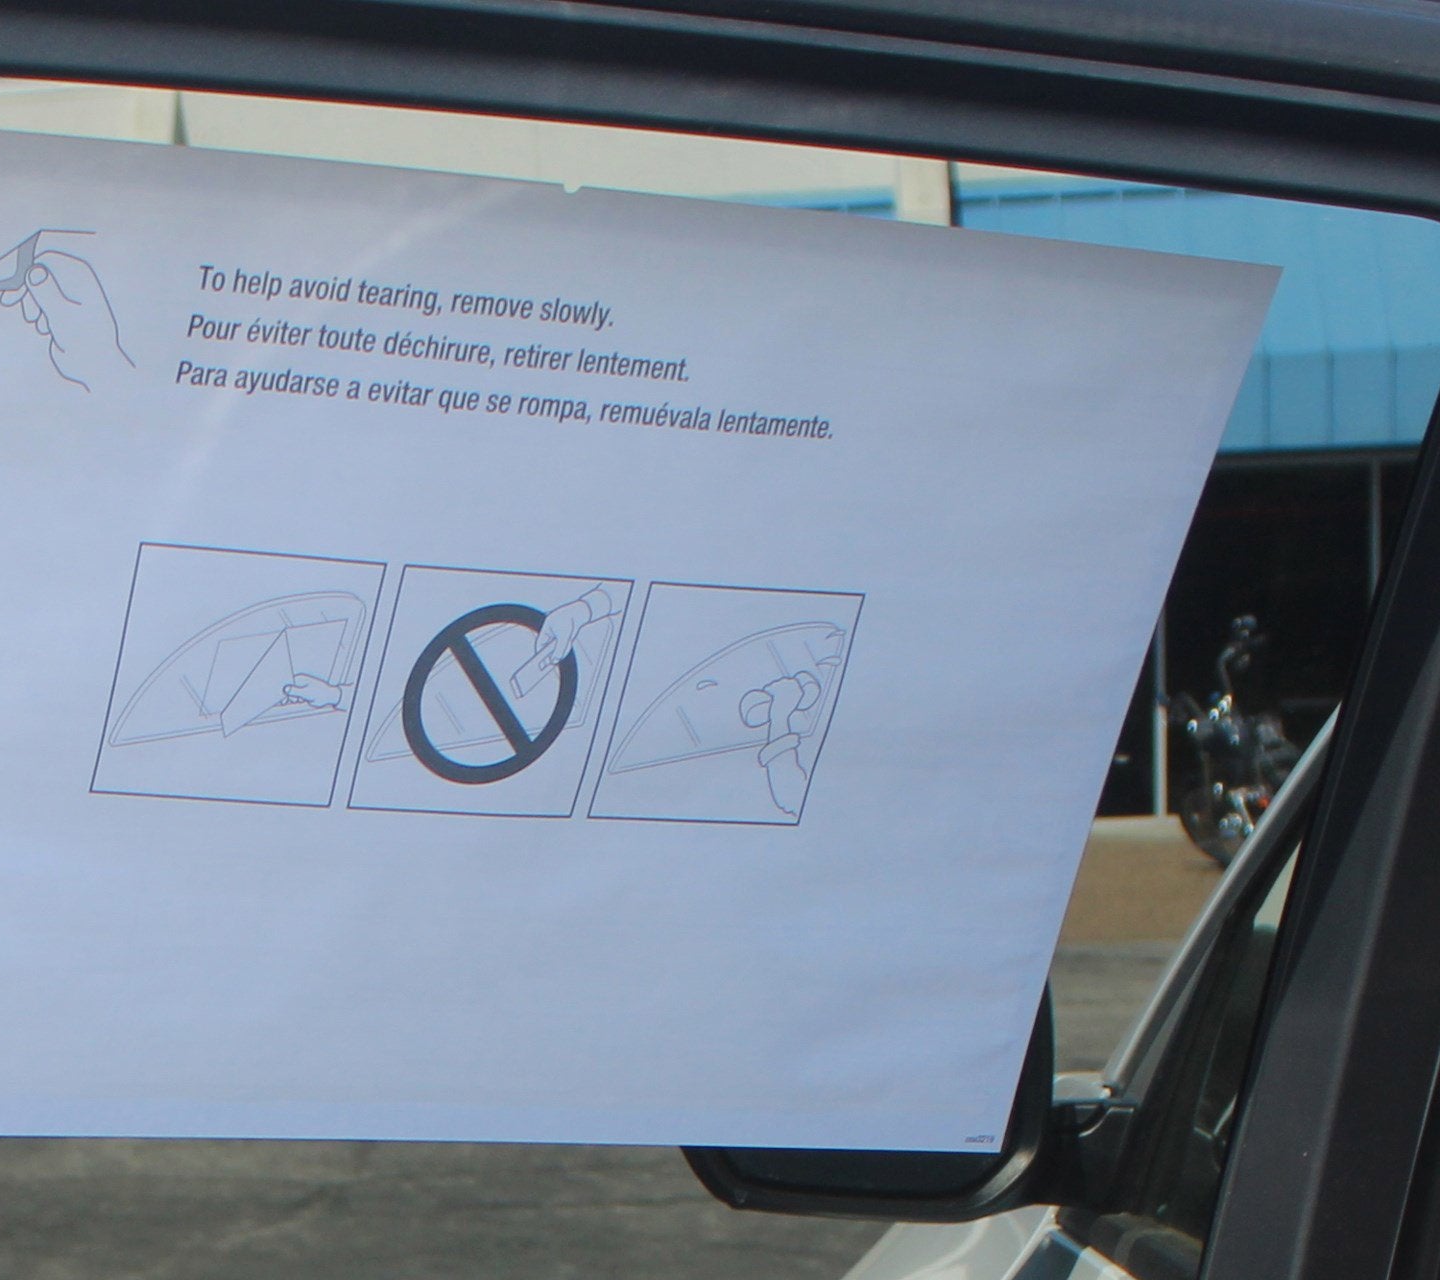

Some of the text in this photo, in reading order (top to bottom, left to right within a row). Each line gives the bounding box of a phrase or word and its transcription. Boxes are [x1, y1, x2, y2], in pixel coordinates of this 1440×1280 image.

[199, 265, 614, 331] To help avoid tearing, remove slowly.
[187, 314, 689, 382] Pour éviter toute déchirure, retirer lentement.
[176, 361, 833, 439] Para ayudarse a evitar que se rompa, remuévala lentamente.
